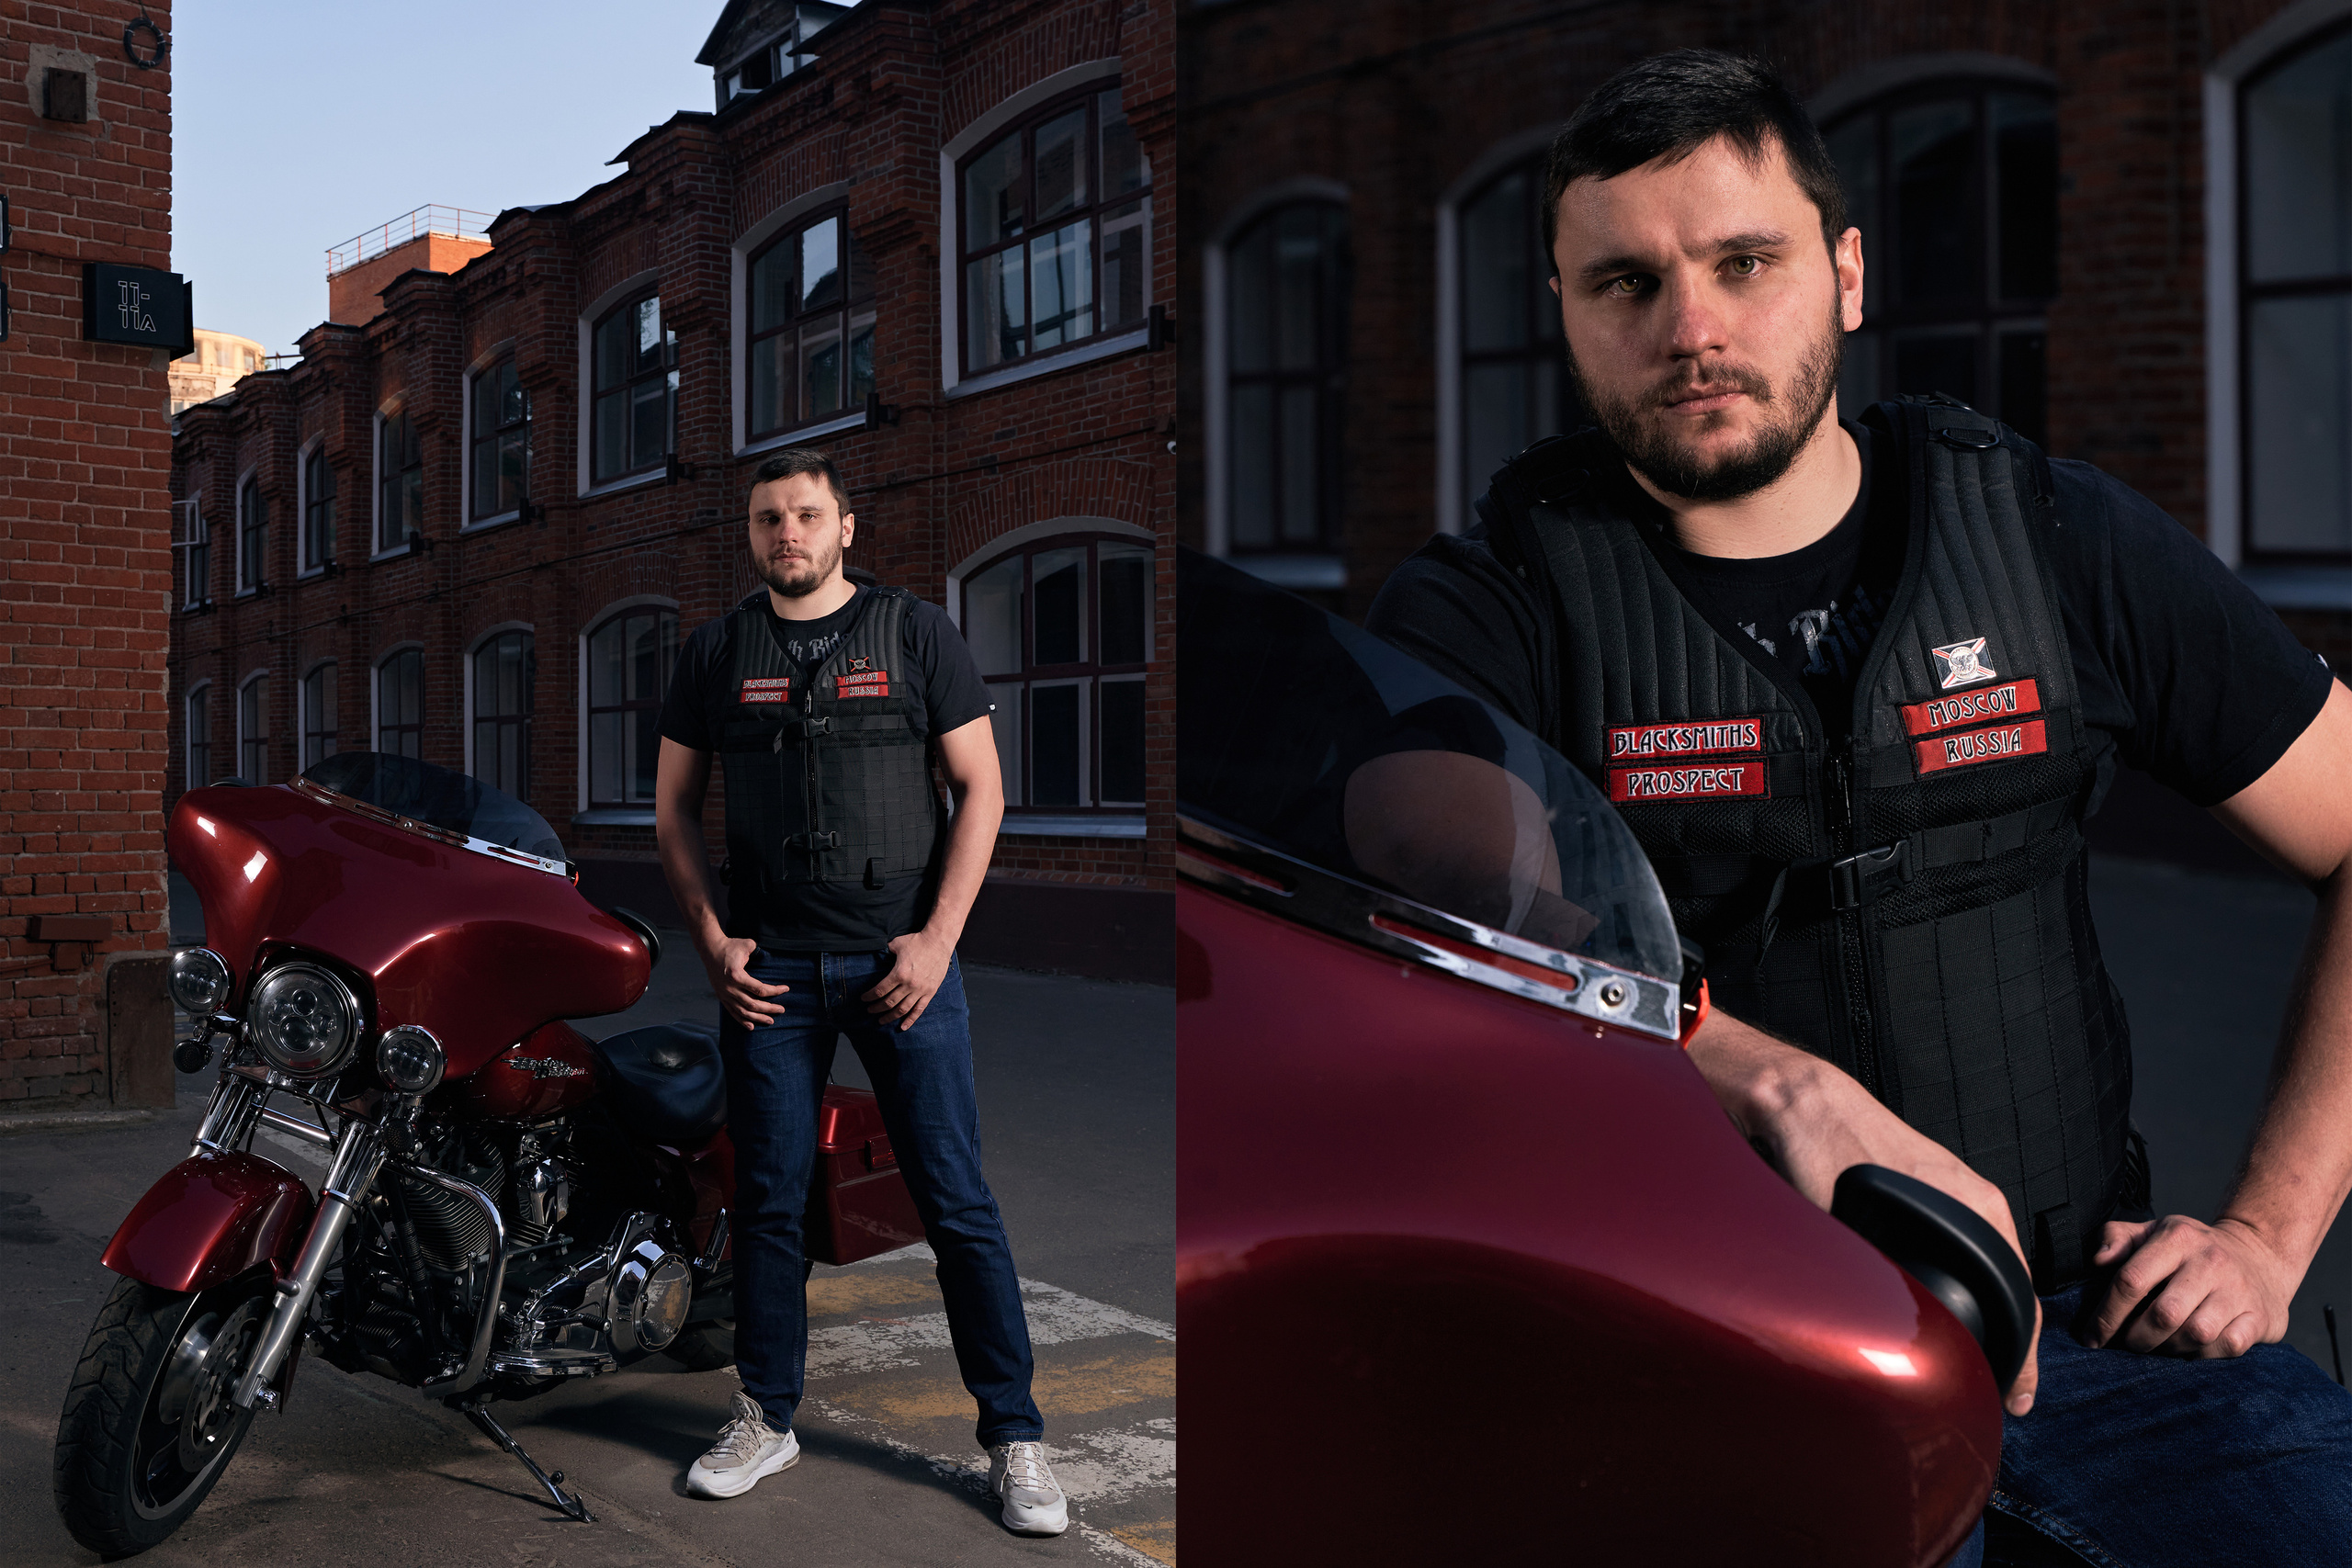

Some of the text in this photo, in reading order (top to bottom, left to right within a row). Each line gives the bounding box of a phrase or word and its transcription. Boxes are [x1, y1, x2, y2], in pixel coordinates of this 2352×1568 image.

[844, 672, 878, 684] MOSCOW
[848, 686, 879, 696] RUSSIA
[745, 692, 783, 702] PROSPECT
[1927, 686, 2018, 728] MOSCOW
[1611, 724, 1758, 757] BLACKSMITHS
[1943, 728, 2023, 763] RUSSIA
[1626, 767, 1745, 797] PROSPECT
